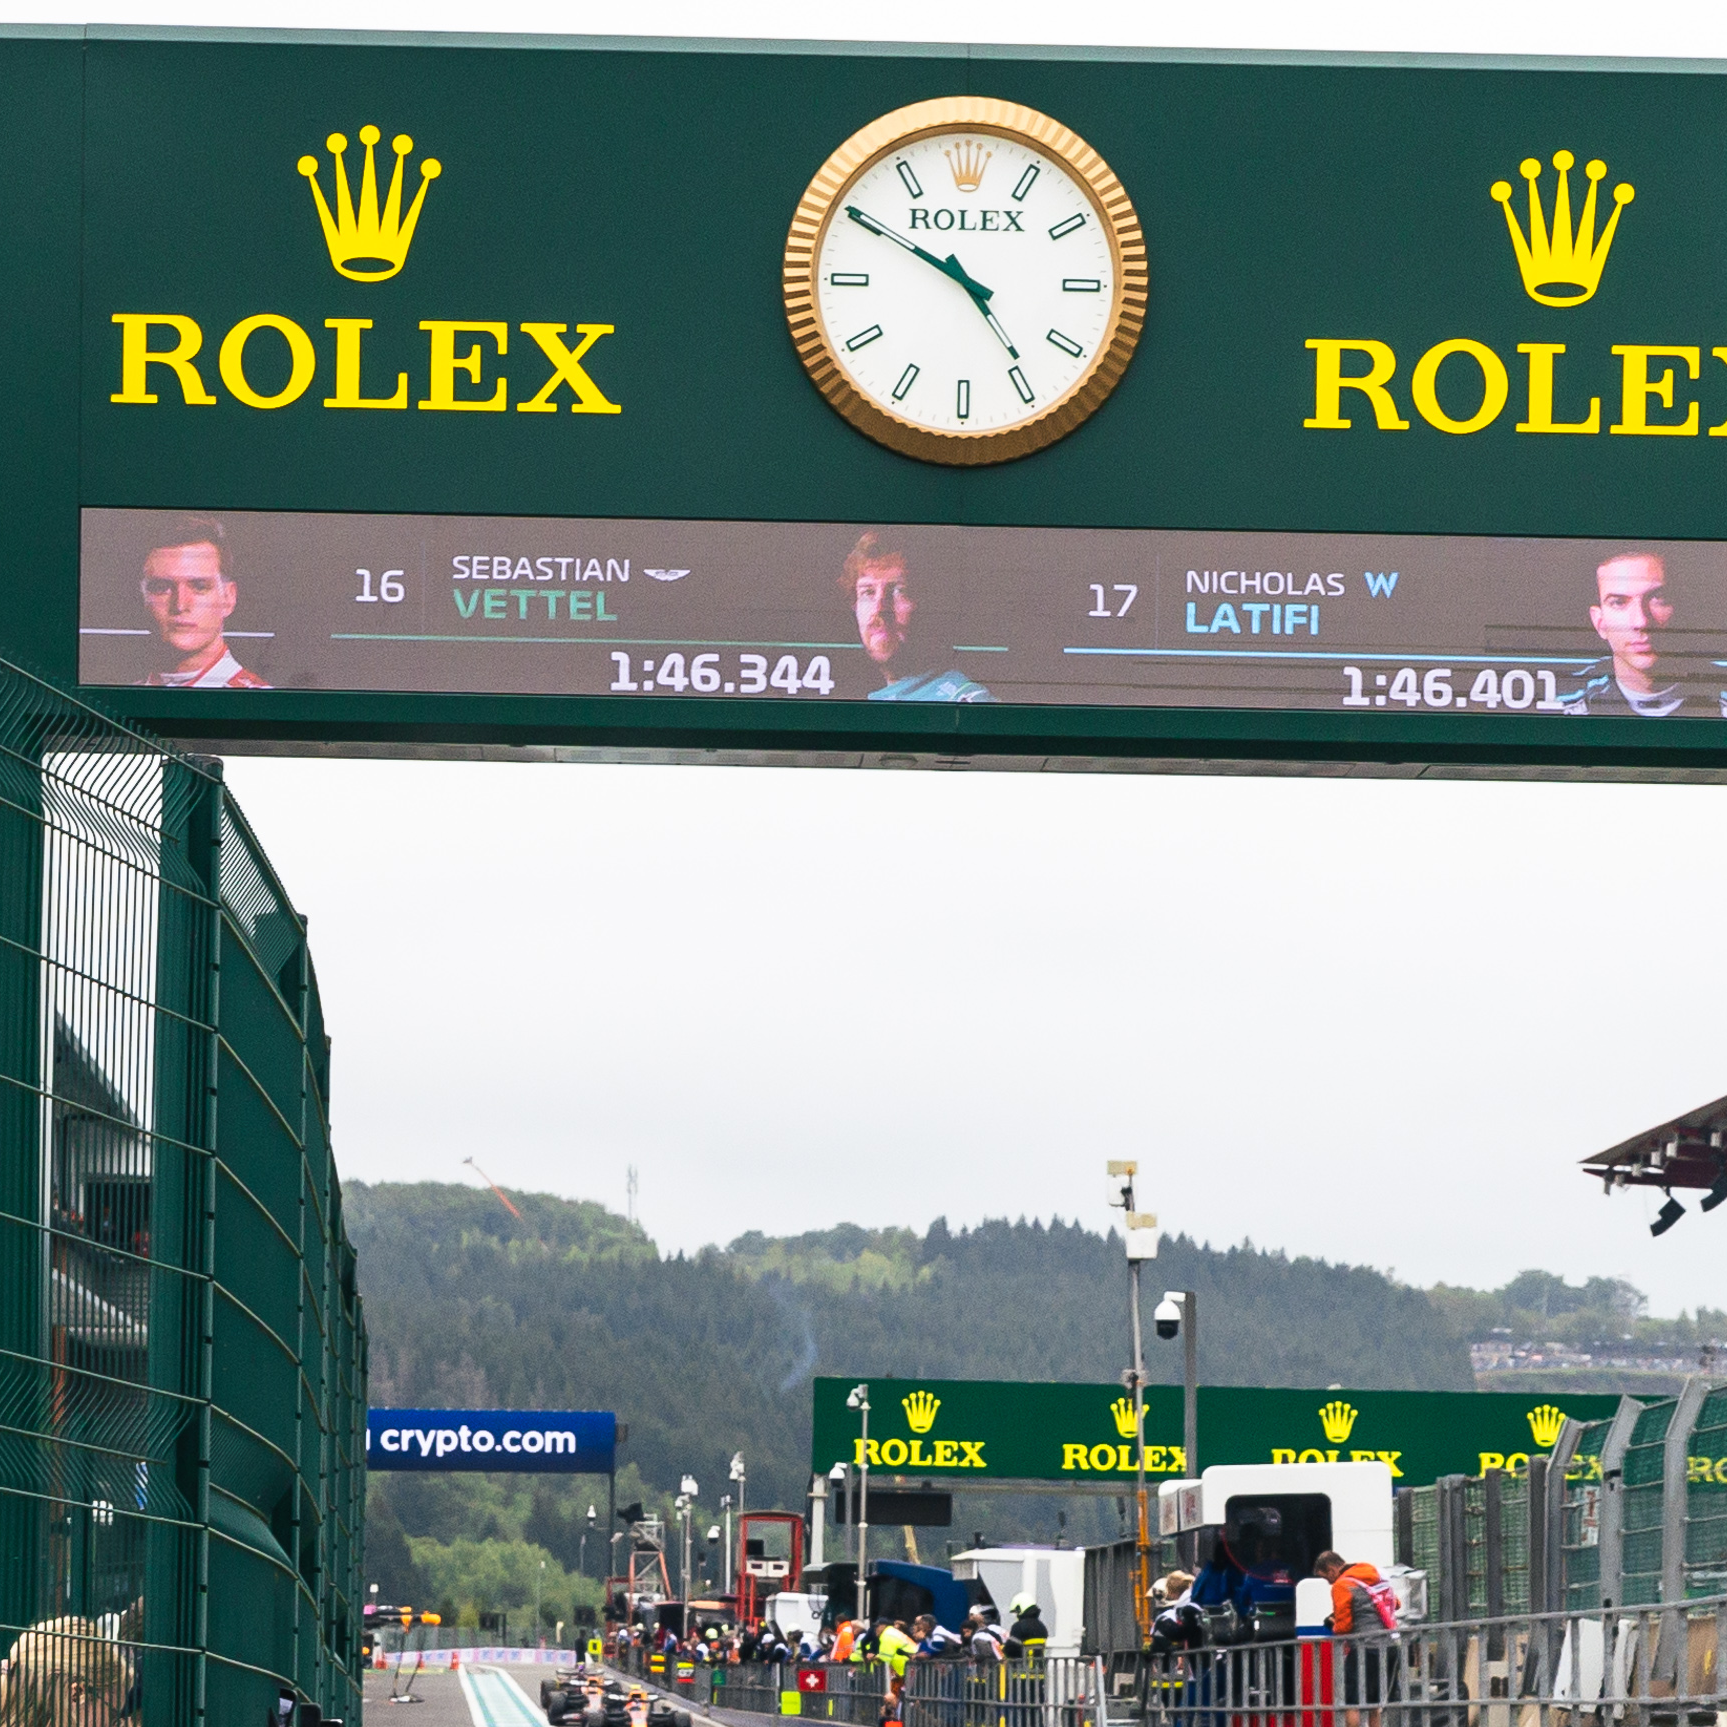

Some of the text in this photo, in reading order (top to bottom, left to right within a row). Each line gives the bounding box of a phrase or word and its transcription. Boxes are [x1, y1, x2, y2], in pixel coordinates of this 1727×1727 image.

[908, 208, 1026, 233] ROLEX
[110, 313, 623, 415] ROLEX
[452, 555, 631, 582] SEBASTIAN
[1185, 570, 1346, 597] NICHOLAS
[354, 568, 406, 604] 16
[1087, 583, 1139, 618] 17
[453, 588, 618, 622] VETTEL
[1185, 601, 1321, 636] LATIFI
[609, 651, 835, 696] 1:46.344
[1342, 665, 1563, 711] 1:46.401
[380, 1424, 577, 1458] crypto.com
[853, 1438, 988, 1469] ROLEX
[1061, 1443, 1188, 1473] ROLEX
